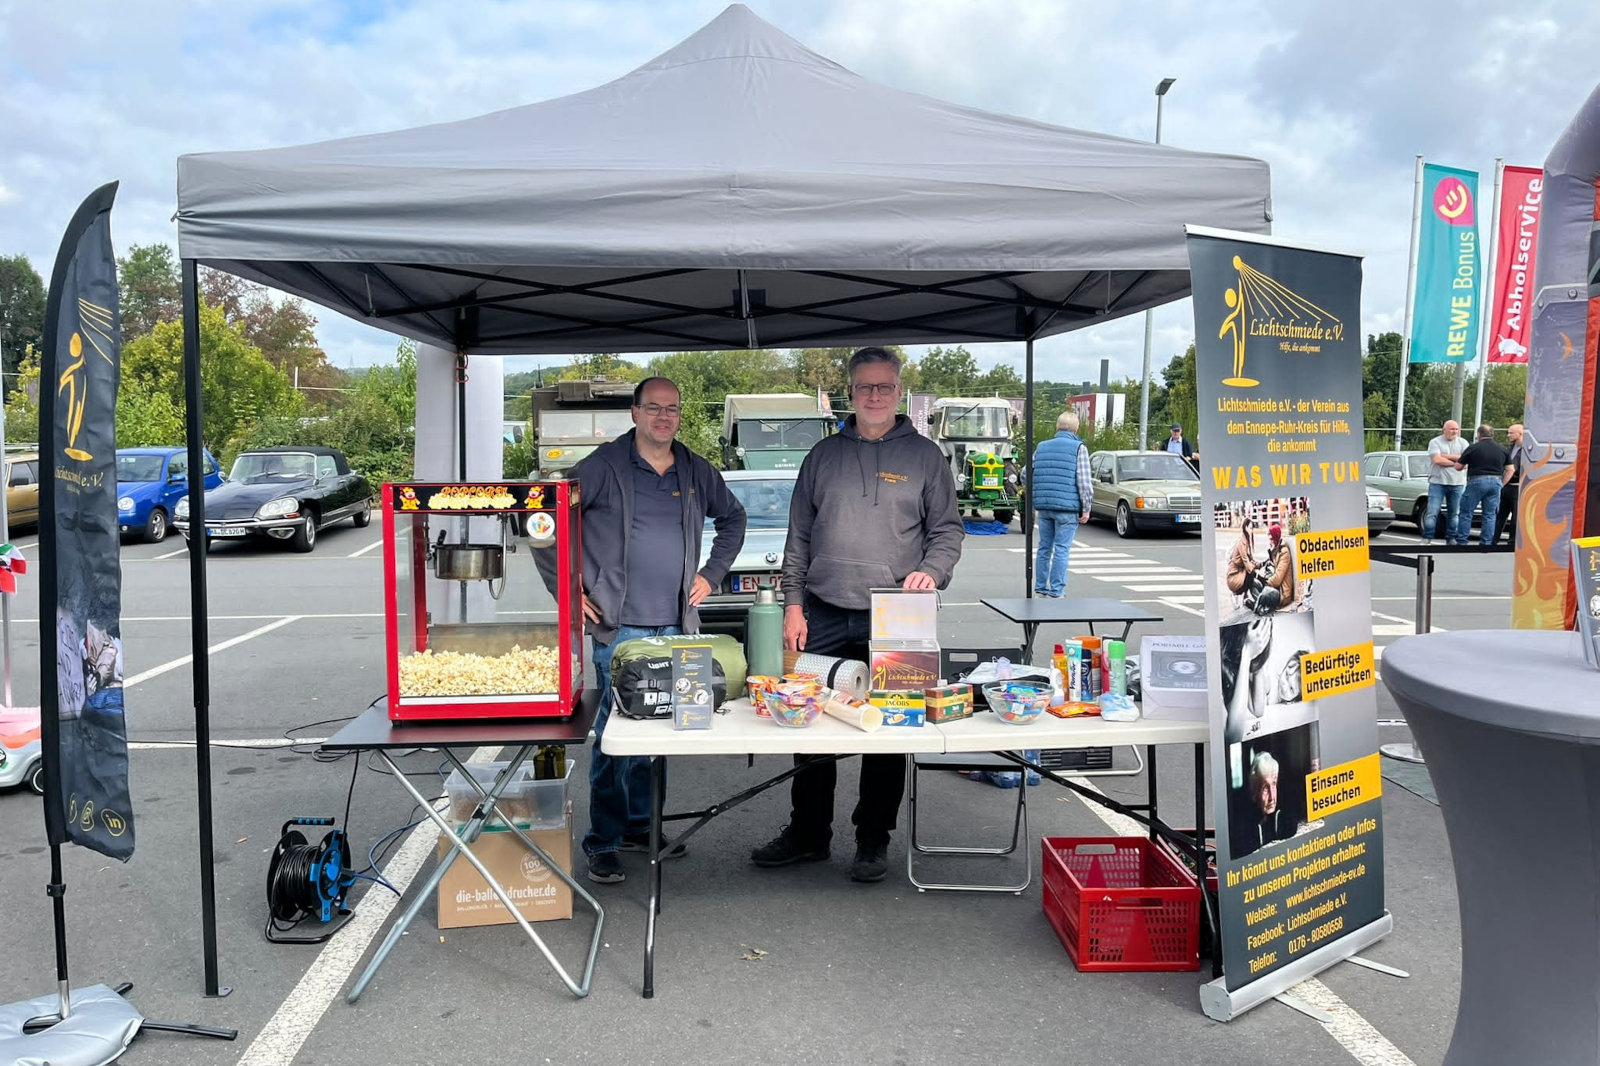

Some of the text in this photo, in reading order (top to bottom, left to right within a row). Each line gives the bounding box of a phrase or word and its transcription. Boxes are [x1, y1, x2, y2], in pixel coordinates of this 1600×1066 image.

[1507, 178, 1543, 331] Abholservice
[1447, 231, 1475, 356] REWE Bonus
[1250, 317, 1344, 341] Lichtschmiede e.V.
[1217, 397, 1277, 412] Lichtschmiede
[1278, 398, 1292, 412] e.V.
[1297, 398, 1310, 413] der
[1311, 399, 1336, 413] Verein
[1336, 402, 1350, 413] aus
[1227, 420, 1350, 436] dem Ennepe-Ruhr-Kreis für Hilfe,
[1267, 438, 1317, 452] die ankommt
[1212, 461, 1360, 490] WAS WIR TUN
[1300, 535, 1365, 553] Obdachlosen
[1301, 558, 1334, 574] helfen
[742, 576, 760, 590] EN
[1305, 651, 1360, 675] Bedürftige
[1306, 669, 1371, 694] unterstützen
[1311, 770, 1354, 794] Einsame
[1312, 786, 1361, 812] besuchen
[1226, 818, 1376, 888] Ihr könnt uns kontaktieren oder Infos
[1243, 842, 1367, 904] zu unseren Projekten erhalten:
[1245, 863, 1366, 926] Website: www.lichtschmiede-ev.de
[1247, 892, 1348, 951] Facebook: Lichtschmiede e.V.
[1248, 951, 1278, 974] Telefon:
[1288, 934, 1306, 954] 0176
[1311, 916, 1344, 943] 80580558
